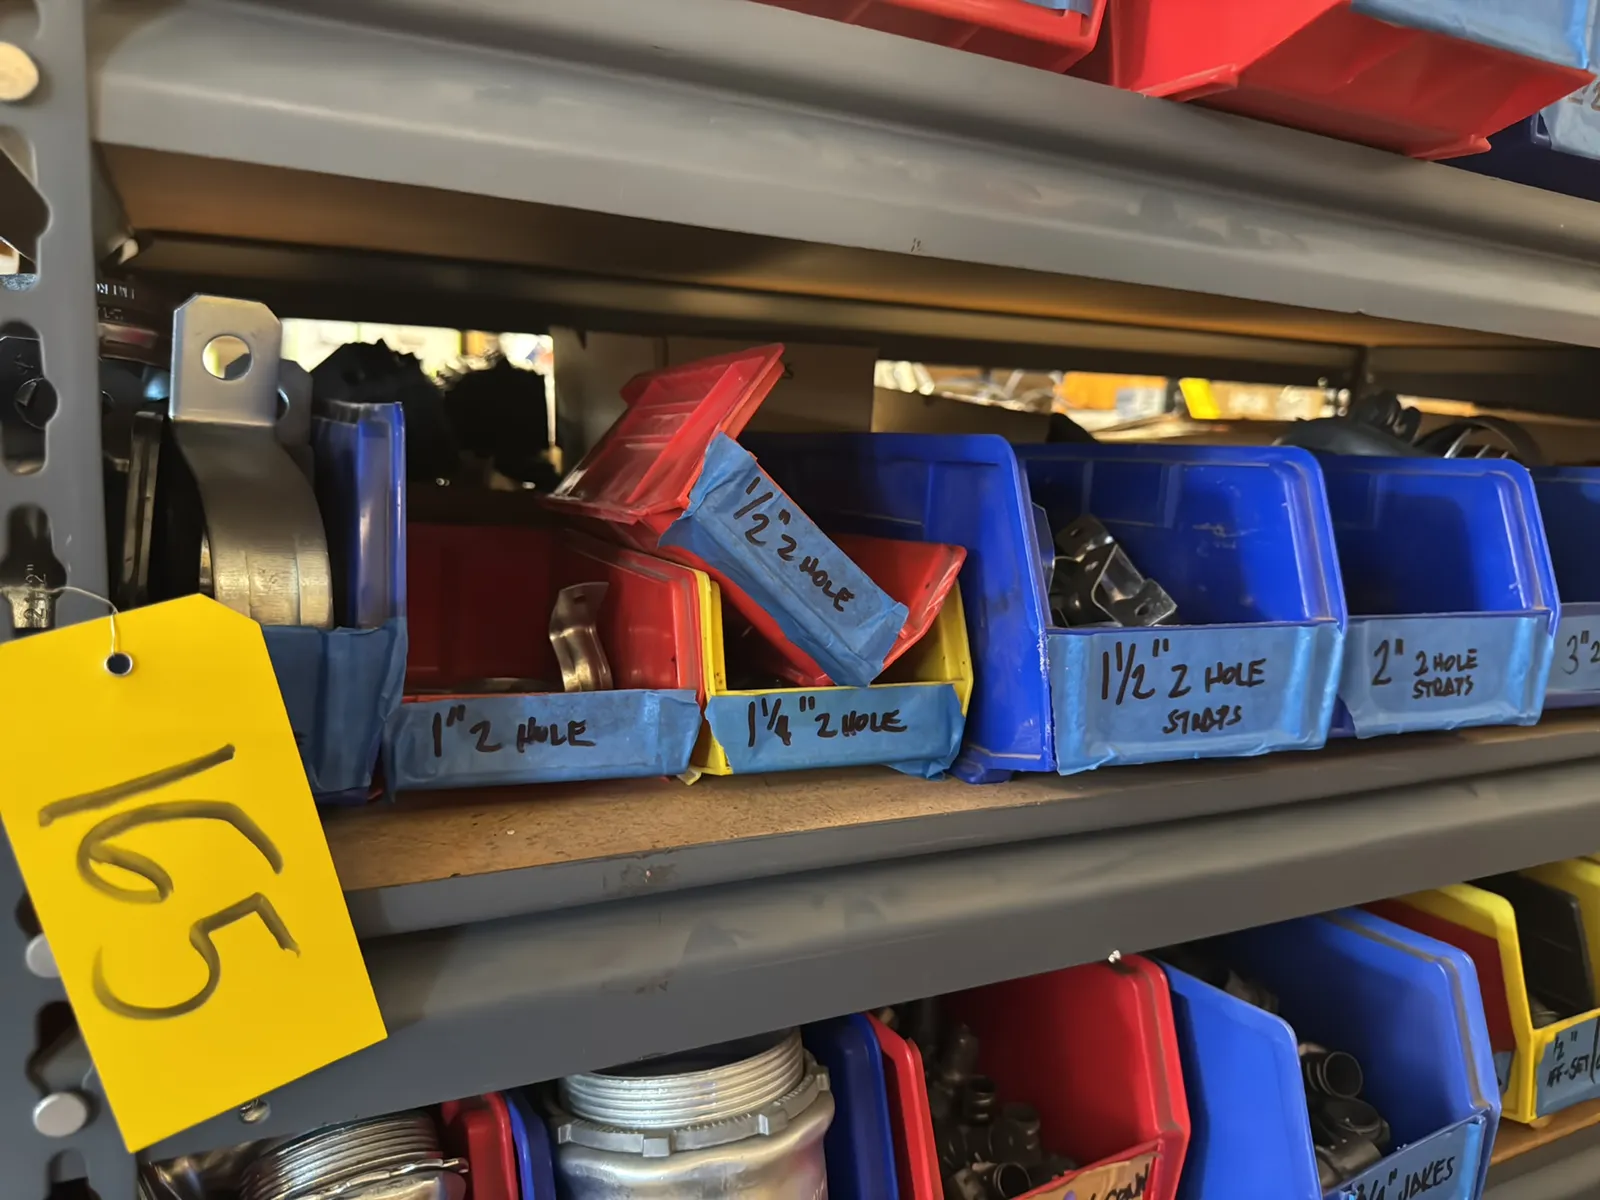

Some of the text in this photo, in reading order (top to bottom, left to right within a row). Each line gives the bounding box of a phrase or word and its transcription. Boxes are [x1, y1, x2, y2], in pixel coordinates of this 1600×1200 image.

[777, 533, 798, 562] 2
[799, 555, 855, 612] HOLE
[1168, 664, 1192, 699] 2
[1205, 658, 1267, 693] HOLE
[1371, 638, 1478, 687] 2" 2 HOLE
[432, 704, 597, 758] 1" 2 HOLE
[814, 713, 838, 738] 2
[842, 709, 908, 737] HOLE
[38, 743, 300, 1021] 165
